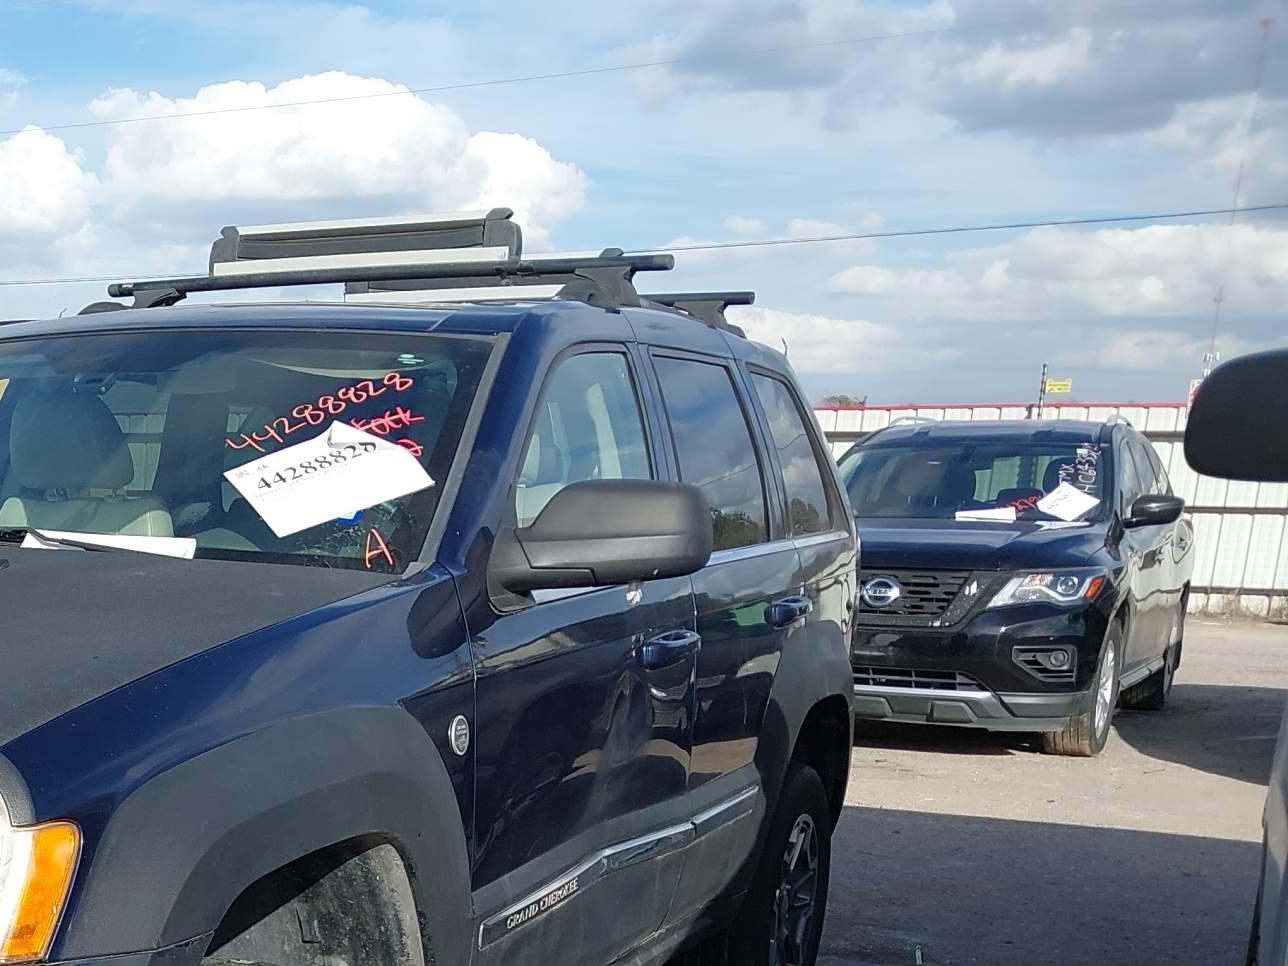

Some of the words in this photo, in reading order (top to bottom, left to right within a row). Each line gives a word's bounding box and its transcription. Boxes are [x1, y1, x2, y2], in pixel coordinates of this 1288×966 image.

[225, 372, 413, 452] 44288828
[257, 441, 377, 489] 44288828
[365, 528, 393, 569] A
[507, 903, 539, 929] GRAND
[540, 877, 579, 910] CHEROKEE
